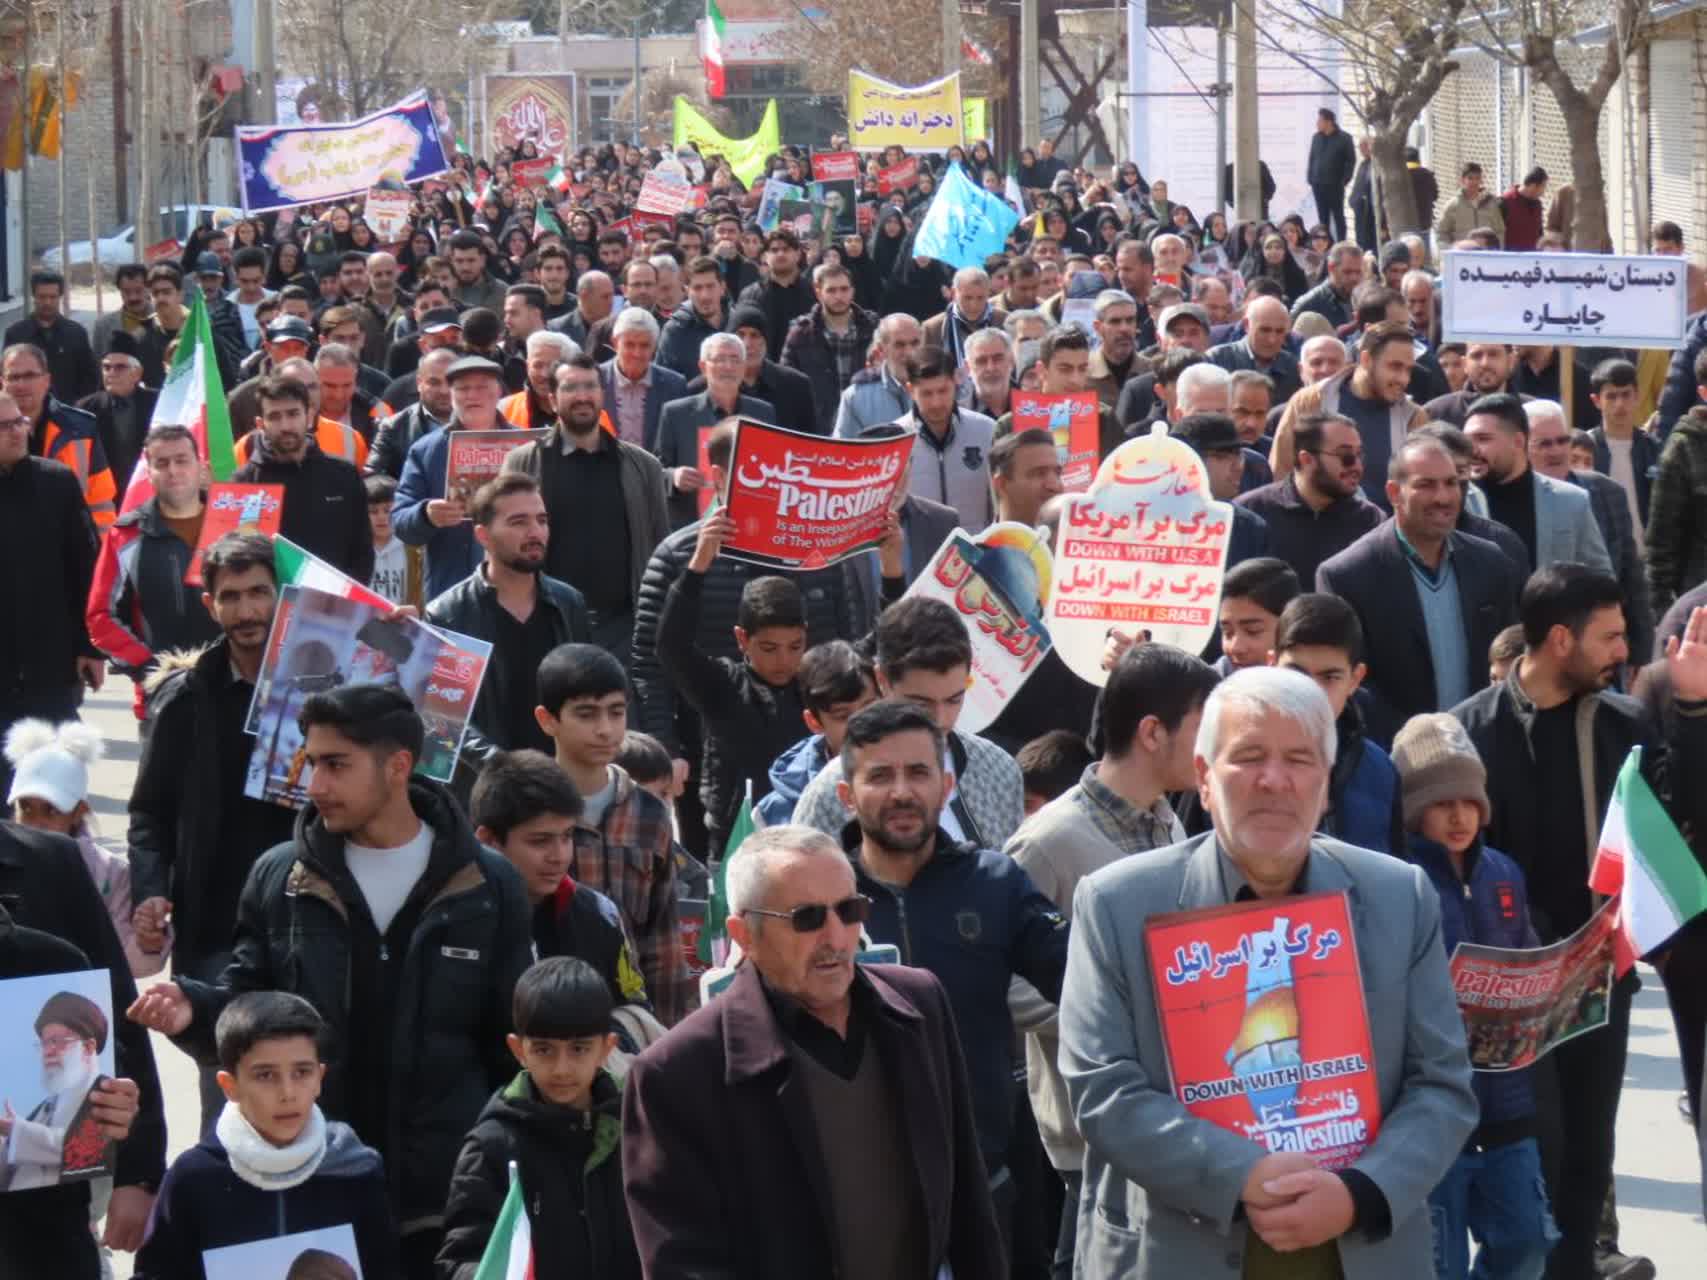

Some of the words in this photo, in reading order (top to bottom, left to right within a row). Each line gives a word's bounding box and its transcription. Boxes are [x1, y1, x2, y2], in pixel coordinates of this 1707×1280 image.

[1459, 261, 1542, 289] فهمیده
[1543, 264, 1608, 289] شهید
[1608, 263, 1676, 292] دبستان
[1523, 303, 1606, 333] چایپاره
[737, 449, 901, 489] فلسطین
[1069, 501, 1152, 538] آمریکا
[1144, 515, 1171, 541] بر
[791, 535, 813, 549] The
[1069, 541, 1121, 559] DOWN
[1125, 544, 1169, 561] WITH
[1058, 563, 1142, 597] اسرائیل
[1141, 577, 1165, 599] بر
[1058, 601, 1106, 617] DOWN
[1111, 605, 1151, 619] WITH
[1154, 606, 1206, 622] ISRAEL
[1166, 933, 1250, 984] اسرائیل
[1258, 938, 1278, 968] بر
[1182, 1077, 1245, 1103] DOWN
[1249, 1067, 1299, 1091] WITH
[1303, 1053, 1368, 1080] ISRAEL
[1264, 1118, 1368, 1153] Palestine
